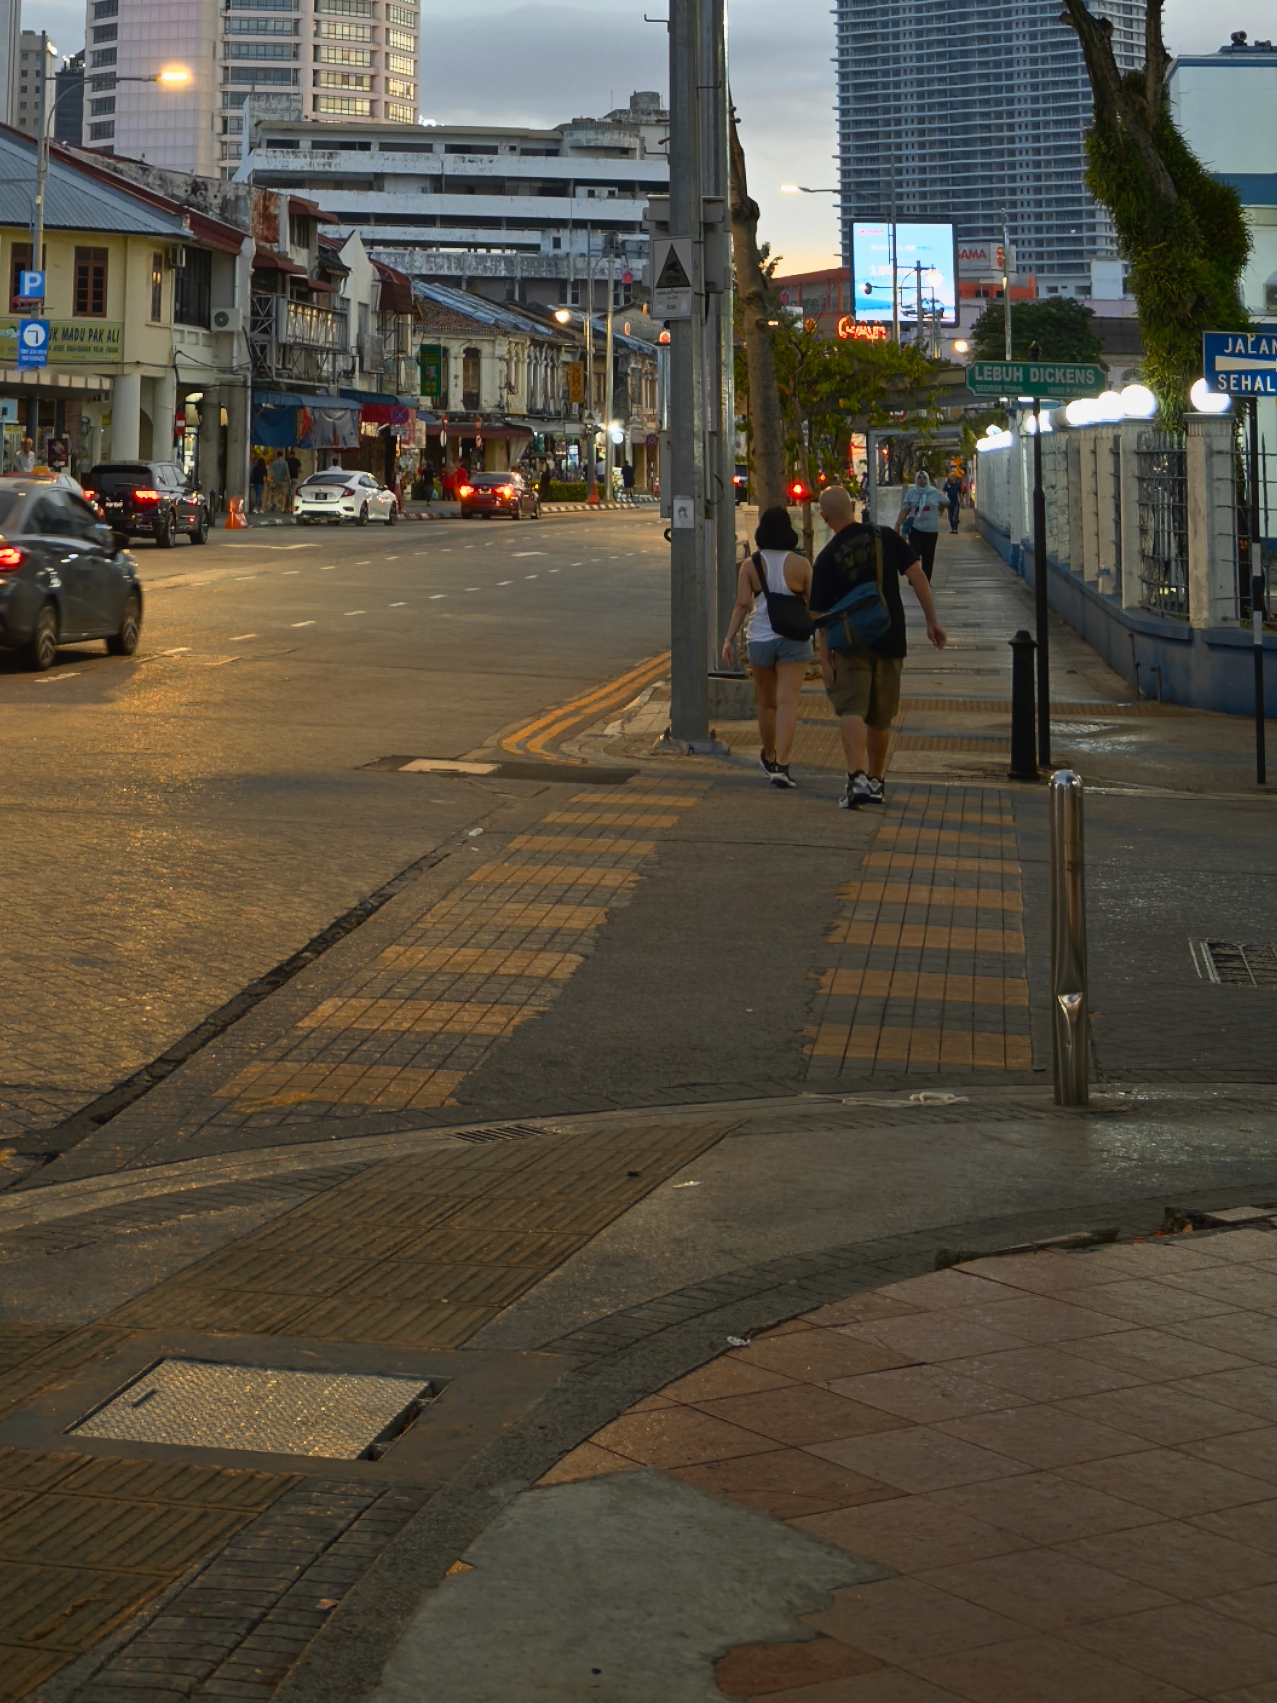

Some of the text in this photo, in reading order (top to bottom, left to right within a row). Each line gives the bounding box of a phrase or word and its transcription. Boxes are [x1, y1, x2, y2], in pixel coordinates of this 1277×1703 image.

[958, 248, 987, 260] AMA
[24, 272, 42, 296] P
[61, 327, 85, 343] MADU
[88, 328, 104, 344] PAK
[107, 329, 120, 344] ALI
[975, 365, 1096, 385] LEBUH DICKENS
[1218, 374, 1276, 392] SEHAL
